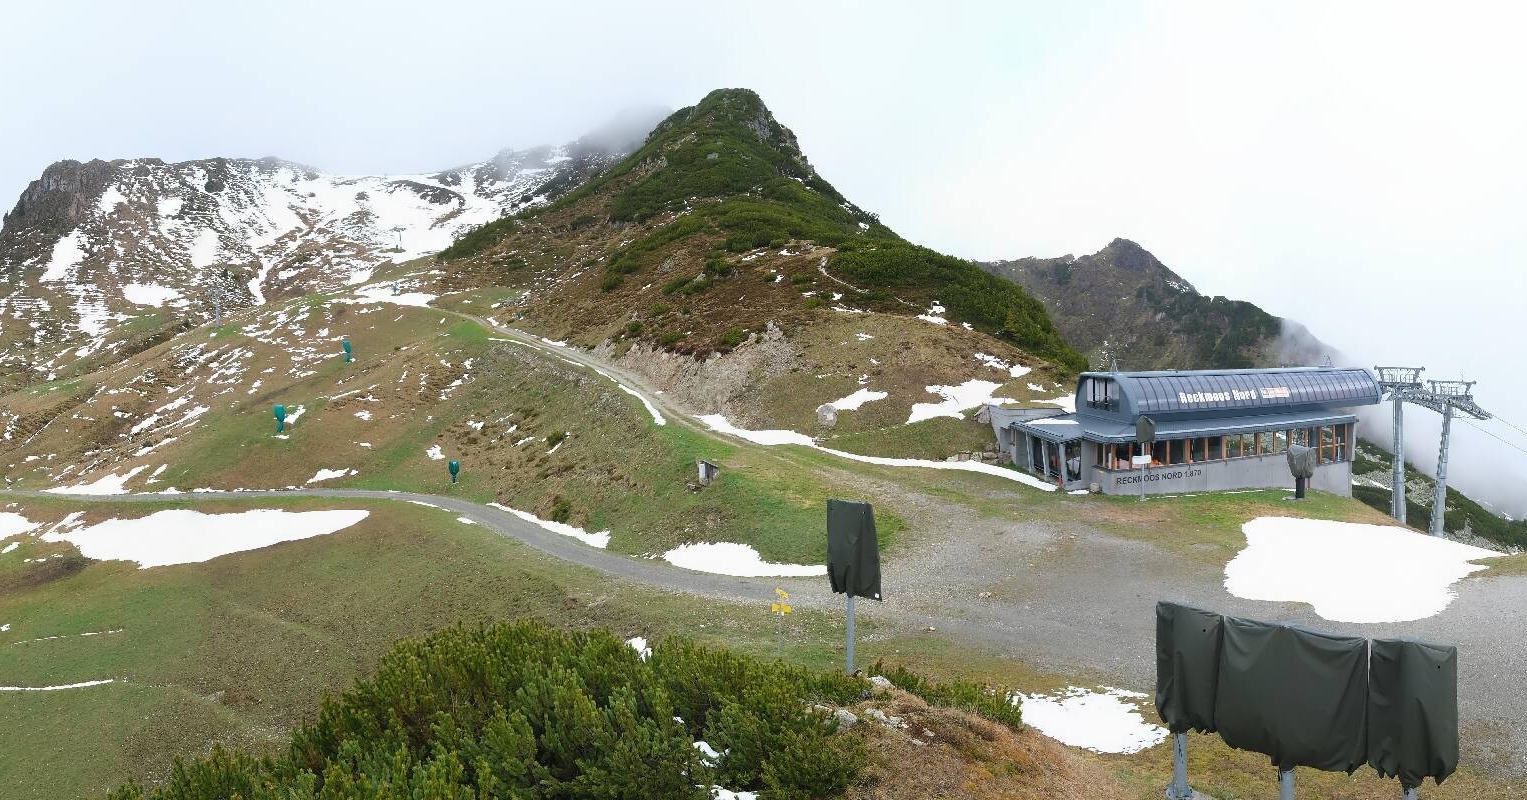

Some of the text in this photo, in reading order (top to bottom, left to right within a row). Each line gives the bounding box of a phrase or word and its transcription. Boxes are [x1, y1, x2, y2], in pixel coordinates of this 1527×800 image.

[1179, 391, 1231, 404] Reckmoos
[1232, 389, 1257, 401] Nord
[1116, 469, 1202, 485] RECKMOOS NORD 1.870
